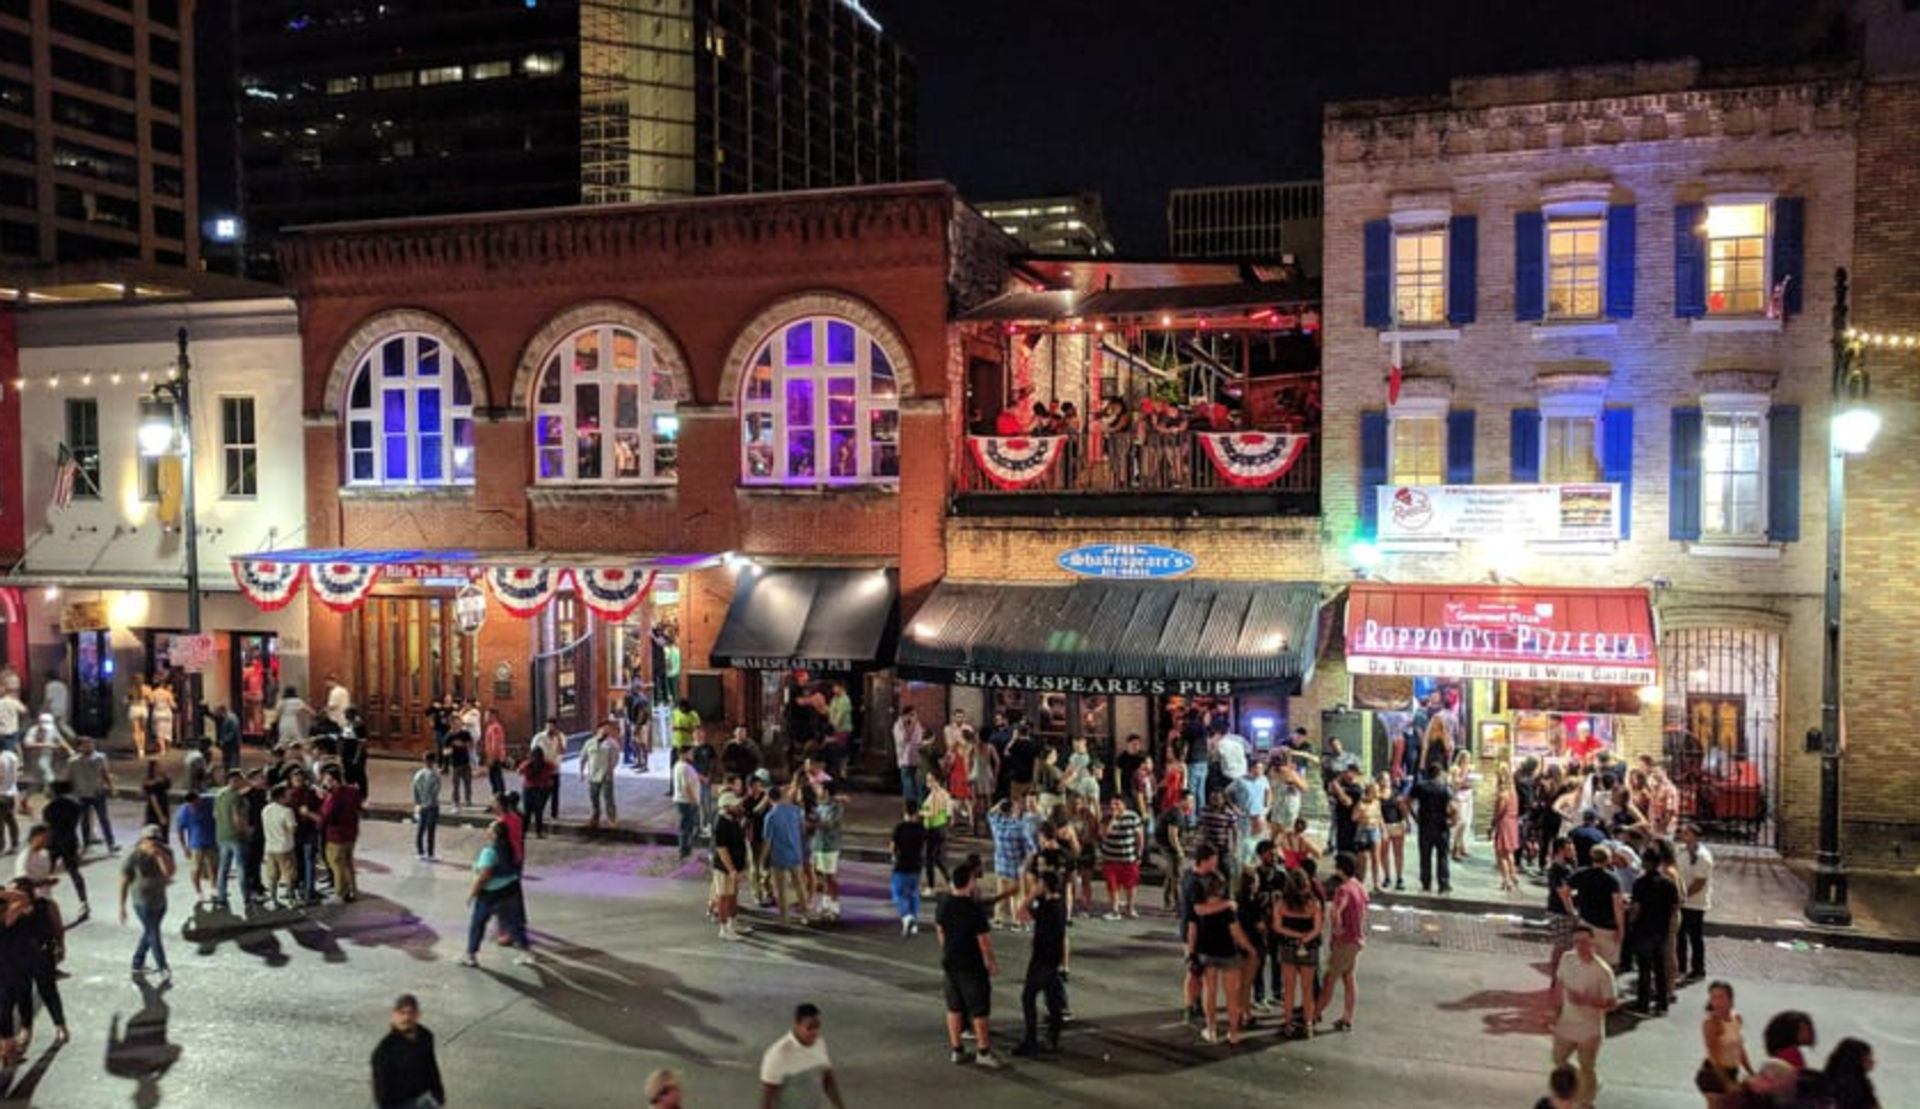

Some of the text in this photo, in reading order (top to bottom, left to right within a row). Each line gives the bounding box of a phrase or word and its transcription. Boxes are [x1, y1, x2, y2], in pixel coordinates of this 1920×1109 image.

[1070, 552, 1184, 569] Shakespeare's
[1455, 610, 1507, 622] Gourmet
[1516, 623, 1640, 660] PIZZERIA
[954, 669, 1233, 696] SHAKESPEARE'S PUB
[1591, 667, 1651, 684] Garden
